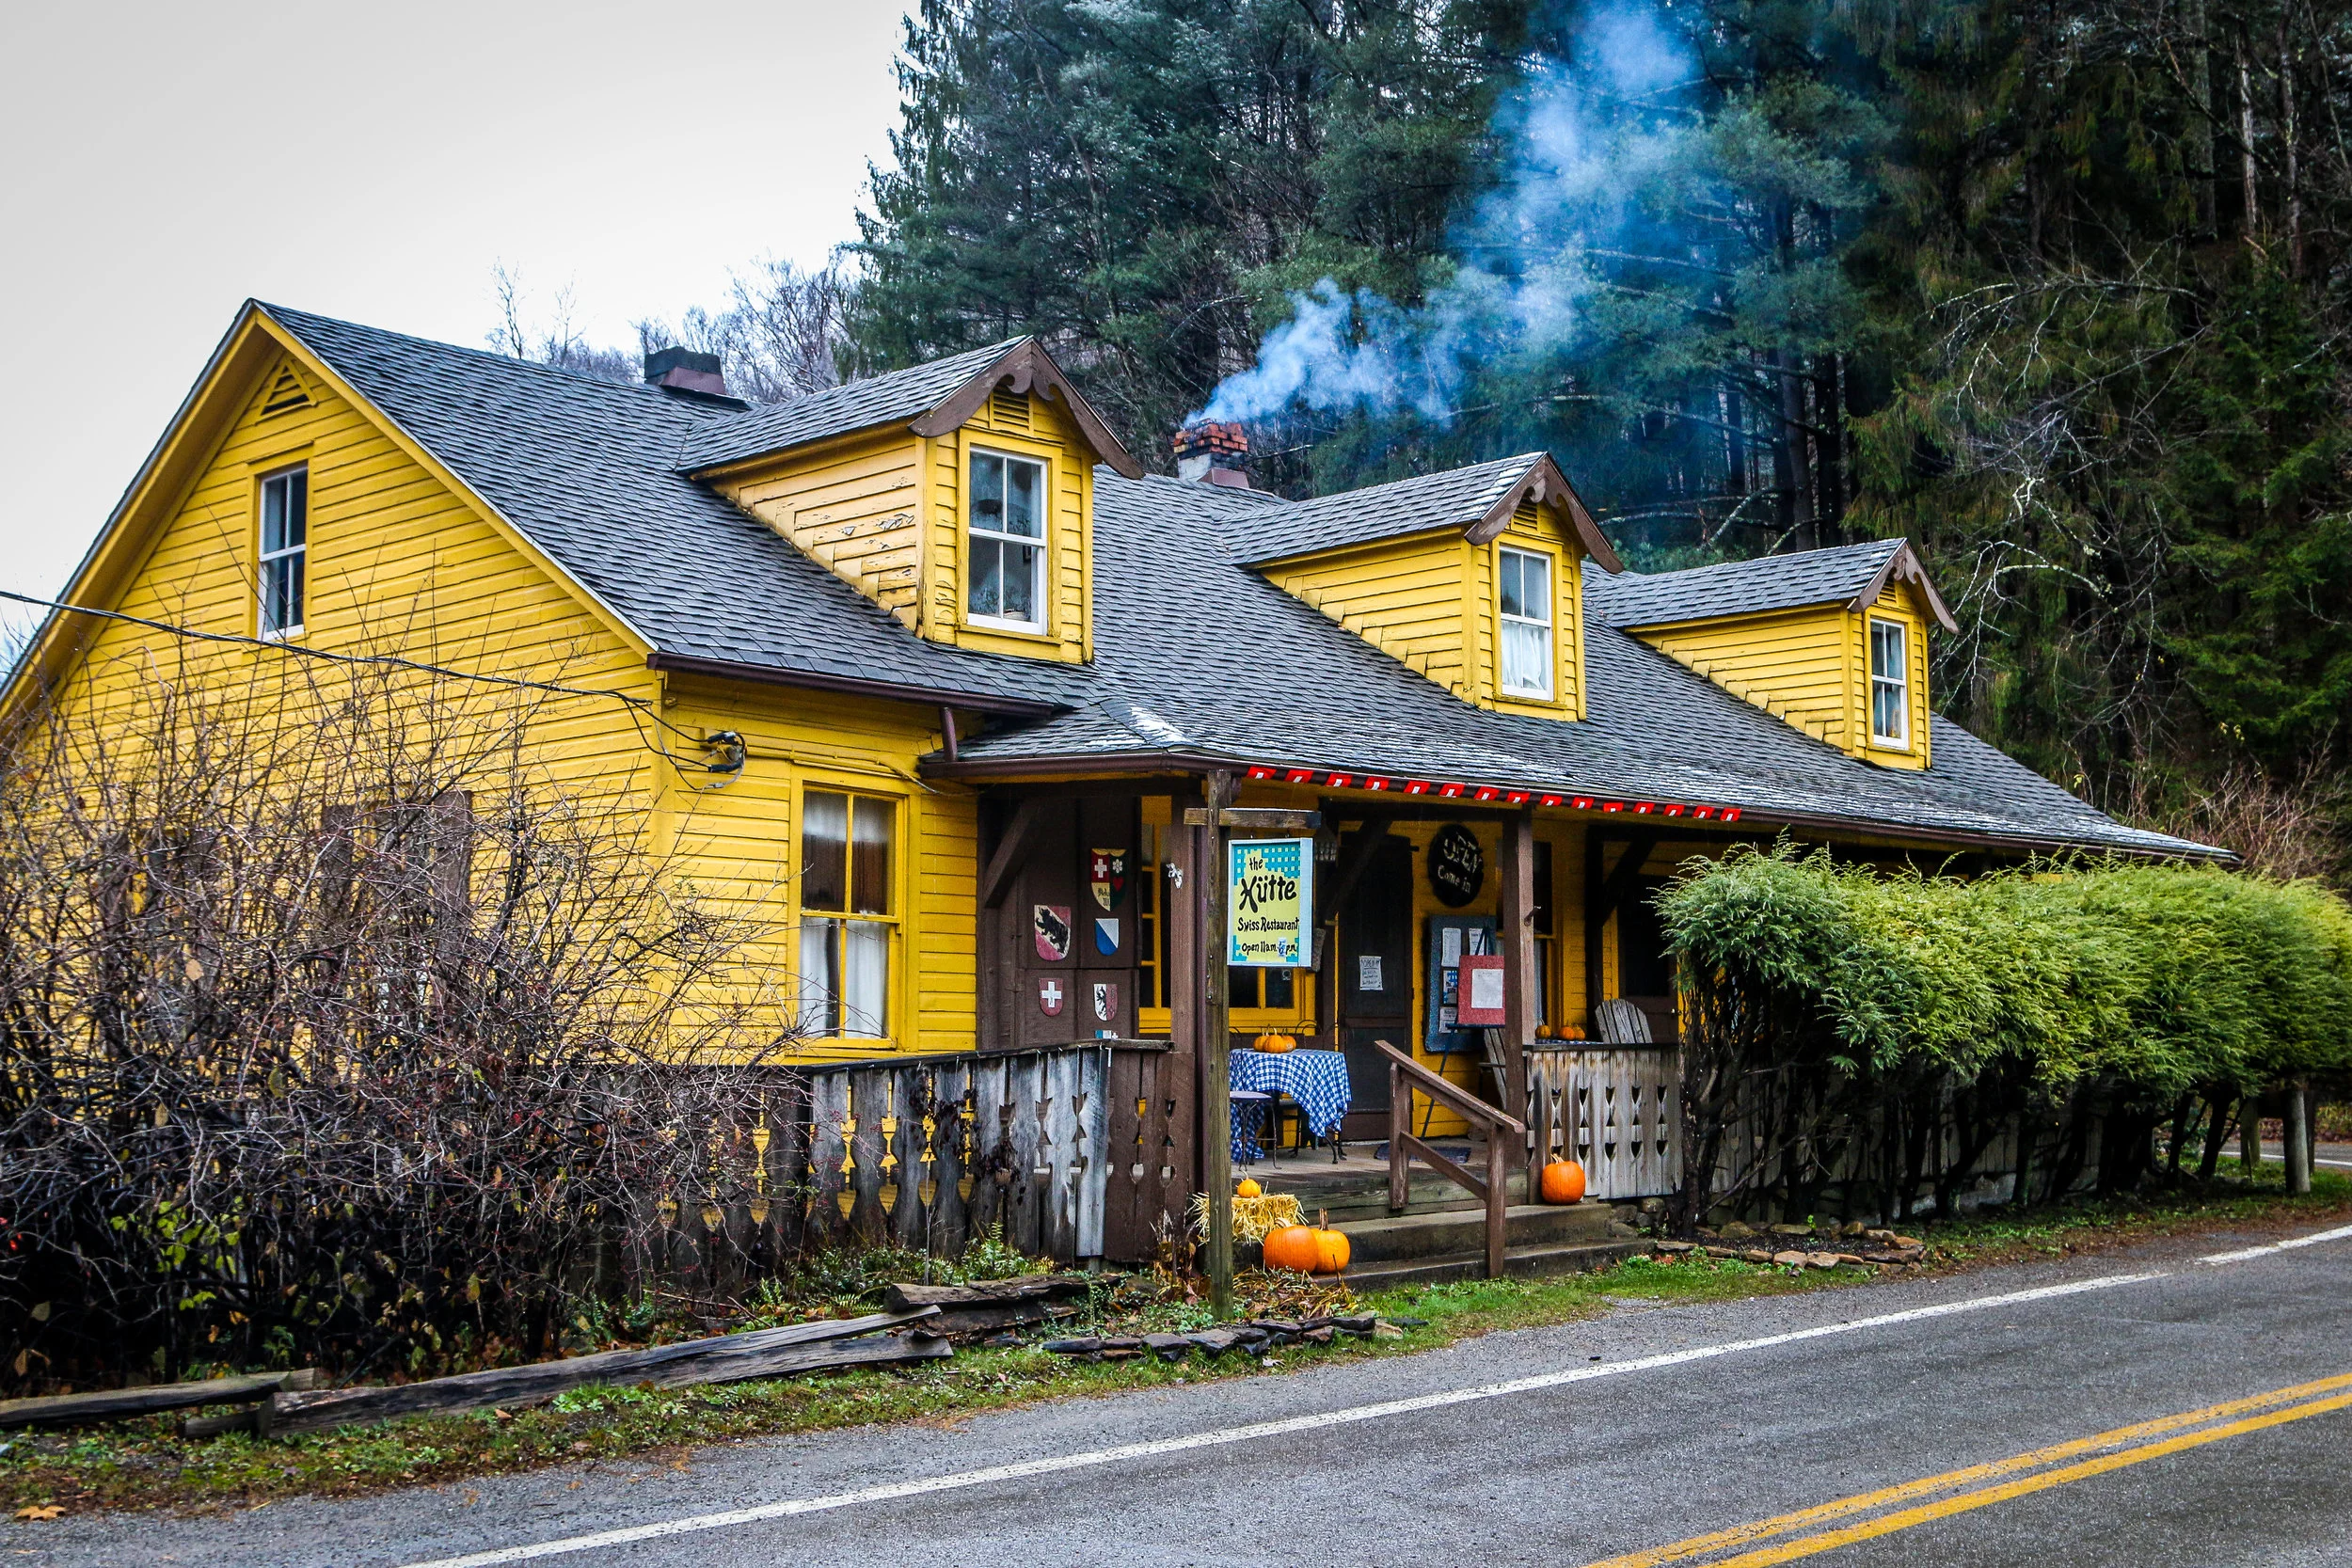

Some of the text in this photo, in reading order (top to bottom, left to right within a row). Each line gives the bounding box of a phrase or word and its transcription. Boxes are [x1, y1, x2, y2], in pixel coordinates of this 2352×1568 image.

[1443, 833, 1482, 873] OPEN
[1248, 857, 1263, 871] the
[1438, 865, 1470, 893] Come in
[1239, 875, 1297, 913] Hütte
[1237, 917, 1299, 932] Swiss Restaurant
[1242, 942, 1259, 956] Open
